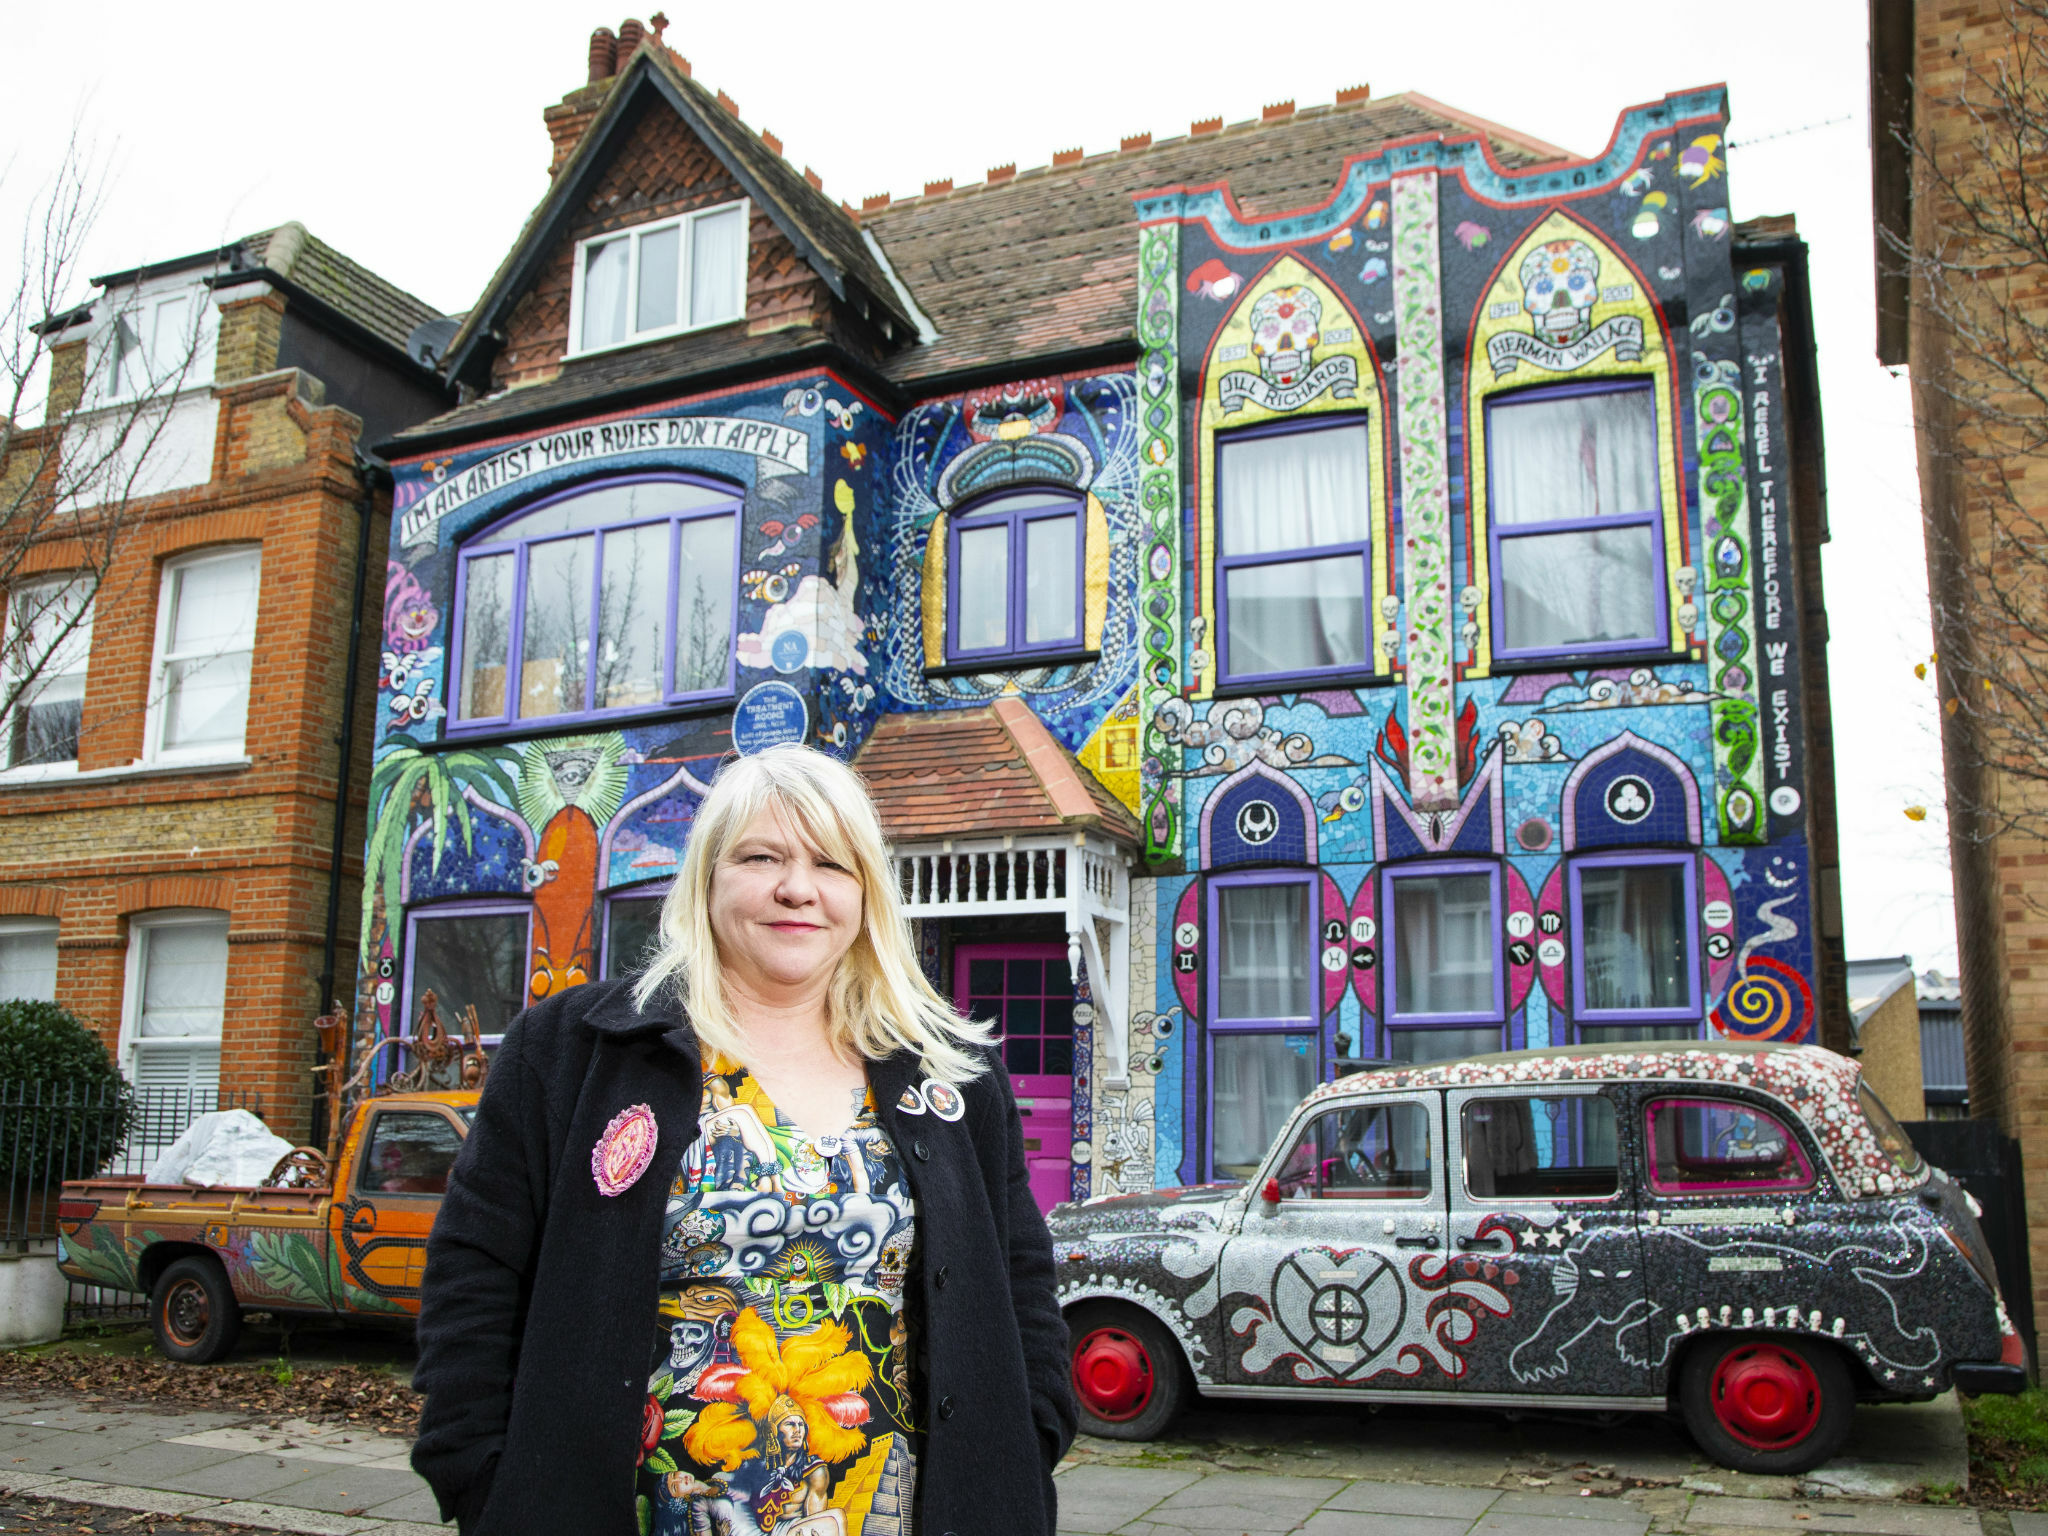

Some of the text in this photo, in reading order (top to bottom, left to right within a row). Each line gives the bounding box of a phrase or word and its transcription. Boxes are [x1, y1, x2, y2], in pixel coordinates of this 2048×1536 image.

[1492, 320, 1637, 366] HERMAN WALLACE
[1224, 360, 1349, 406] JILL RICHARDS
[1752, 391, 1772, 473] REBEL
[435, 478, 463, 515] AN
[466, 443, 532, 499] ARTIST
[538, 430, 594, 465] YOUR
[600, 421, 660, 453] RULES
[725, 422, 801, 460] APPLY
[1759, 480, 1782, 630] THEREFORE
[1765, 641, 1788, 676] WE
[745, 701, 794, 714] TREATMENT
[1771, 689, 1791, 780] EXIST
